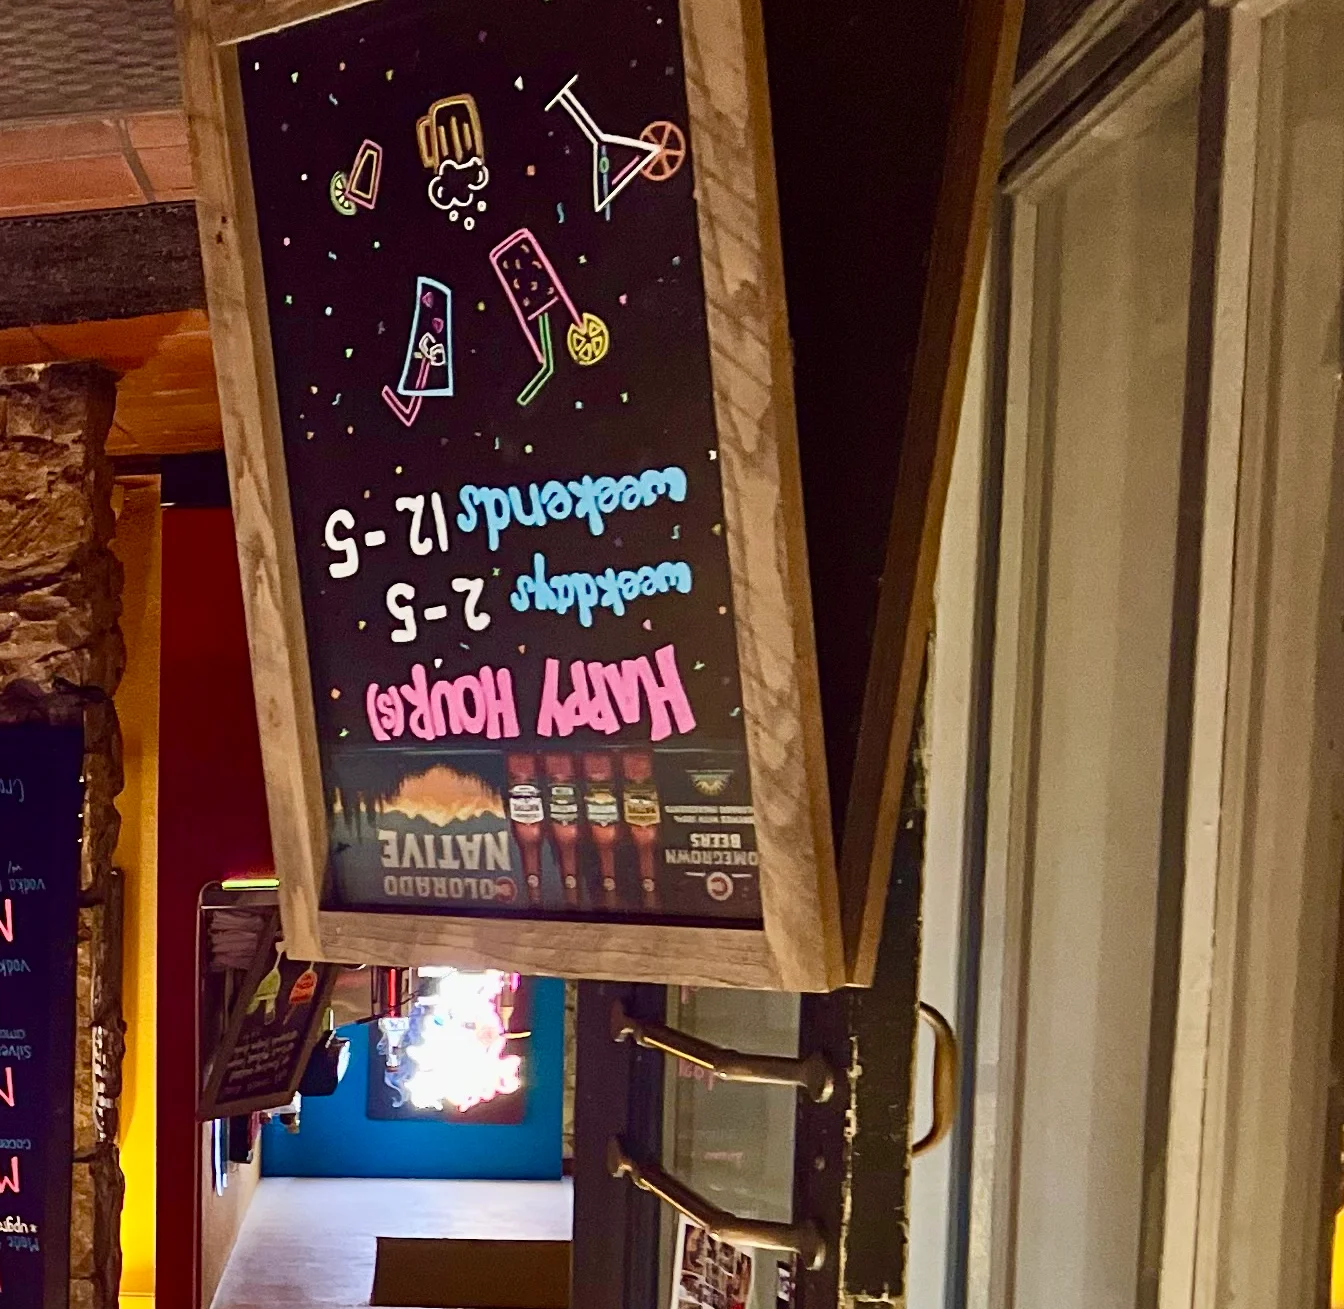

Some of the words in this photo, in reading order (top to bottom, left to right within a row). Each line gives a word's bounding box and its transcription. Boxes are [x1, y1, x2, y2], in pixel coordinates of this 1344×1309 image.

[455, 466, 688, 552] weekends
[509, 552, 692, 628] weekdays
[536, 643, 696, 742] HAPPY
[376, 829, 511, 872] NATIVE
[664, 846, 758, 865] OMEGROWN
[689, 831, 741, 850] BEERS
[383, 875, 516, 904] COLORADO
